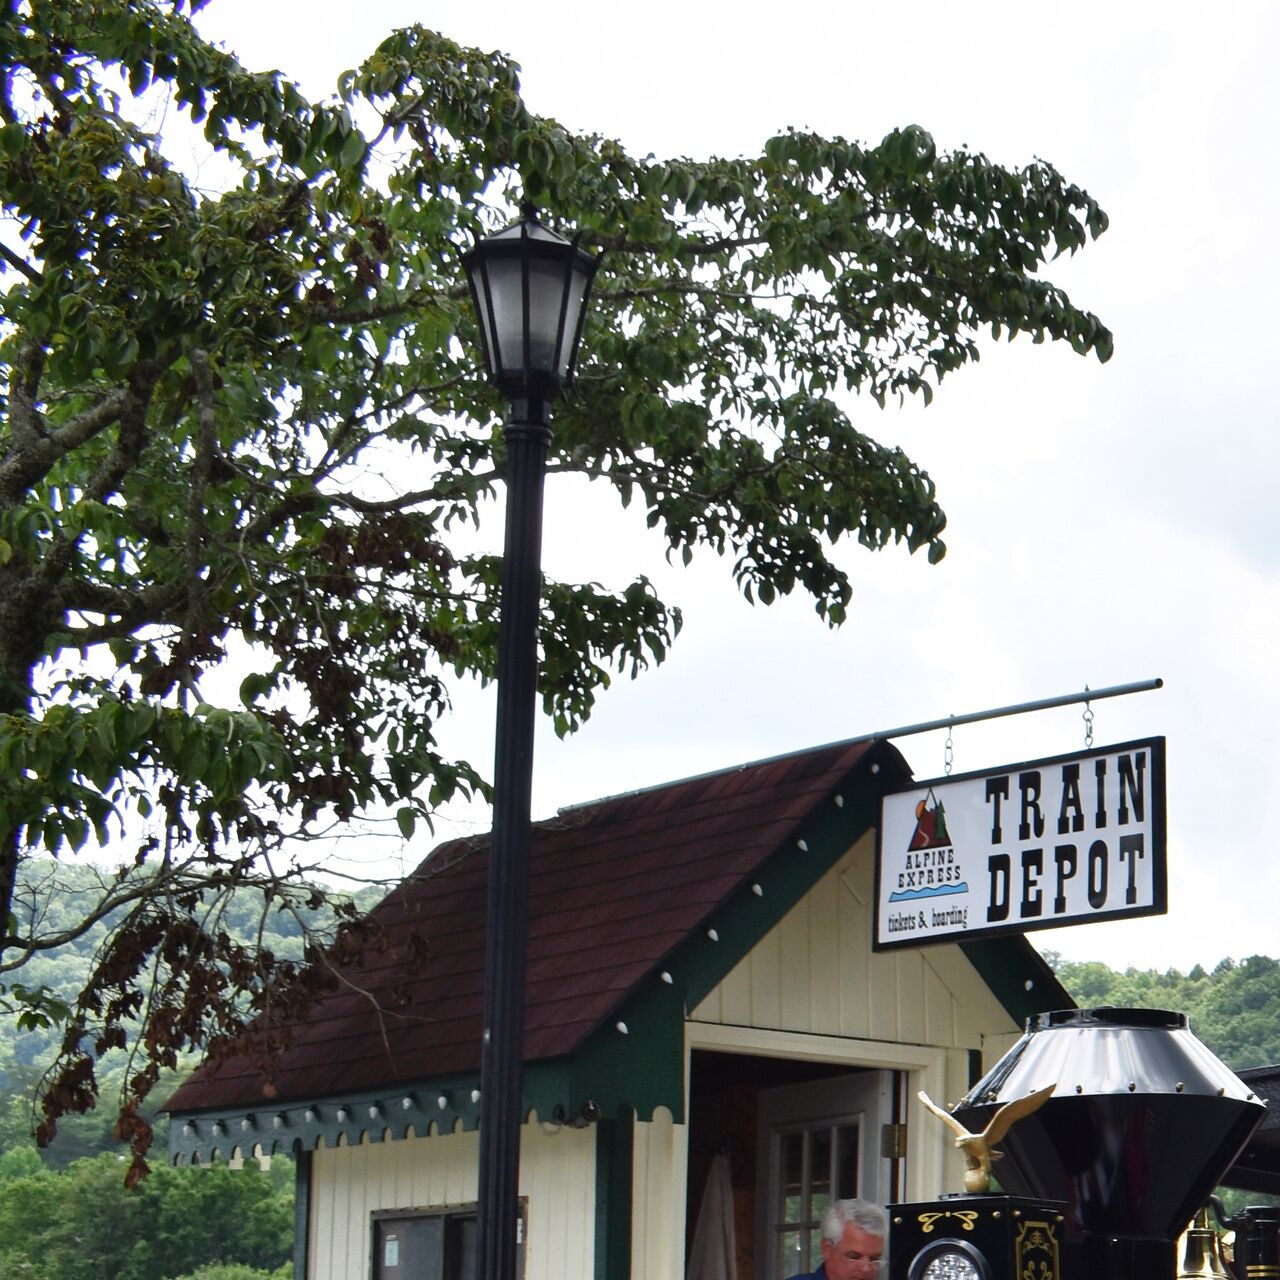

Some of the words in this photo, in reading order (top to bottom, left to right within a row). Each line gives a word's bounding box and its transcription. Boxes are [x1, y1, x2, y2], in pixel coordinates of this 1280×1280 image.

[986, 751, 1146, 844] TRAIN
[906, 849, 954, 870] ALPINE
[898, 865, 961, 888] EXPRESS
[986, 833, 1144, 922] DEPOT
[888, 912, 916, 933] tickets
[919, 911, 928, 929] &
[932, 905, 968, 929] boarding
